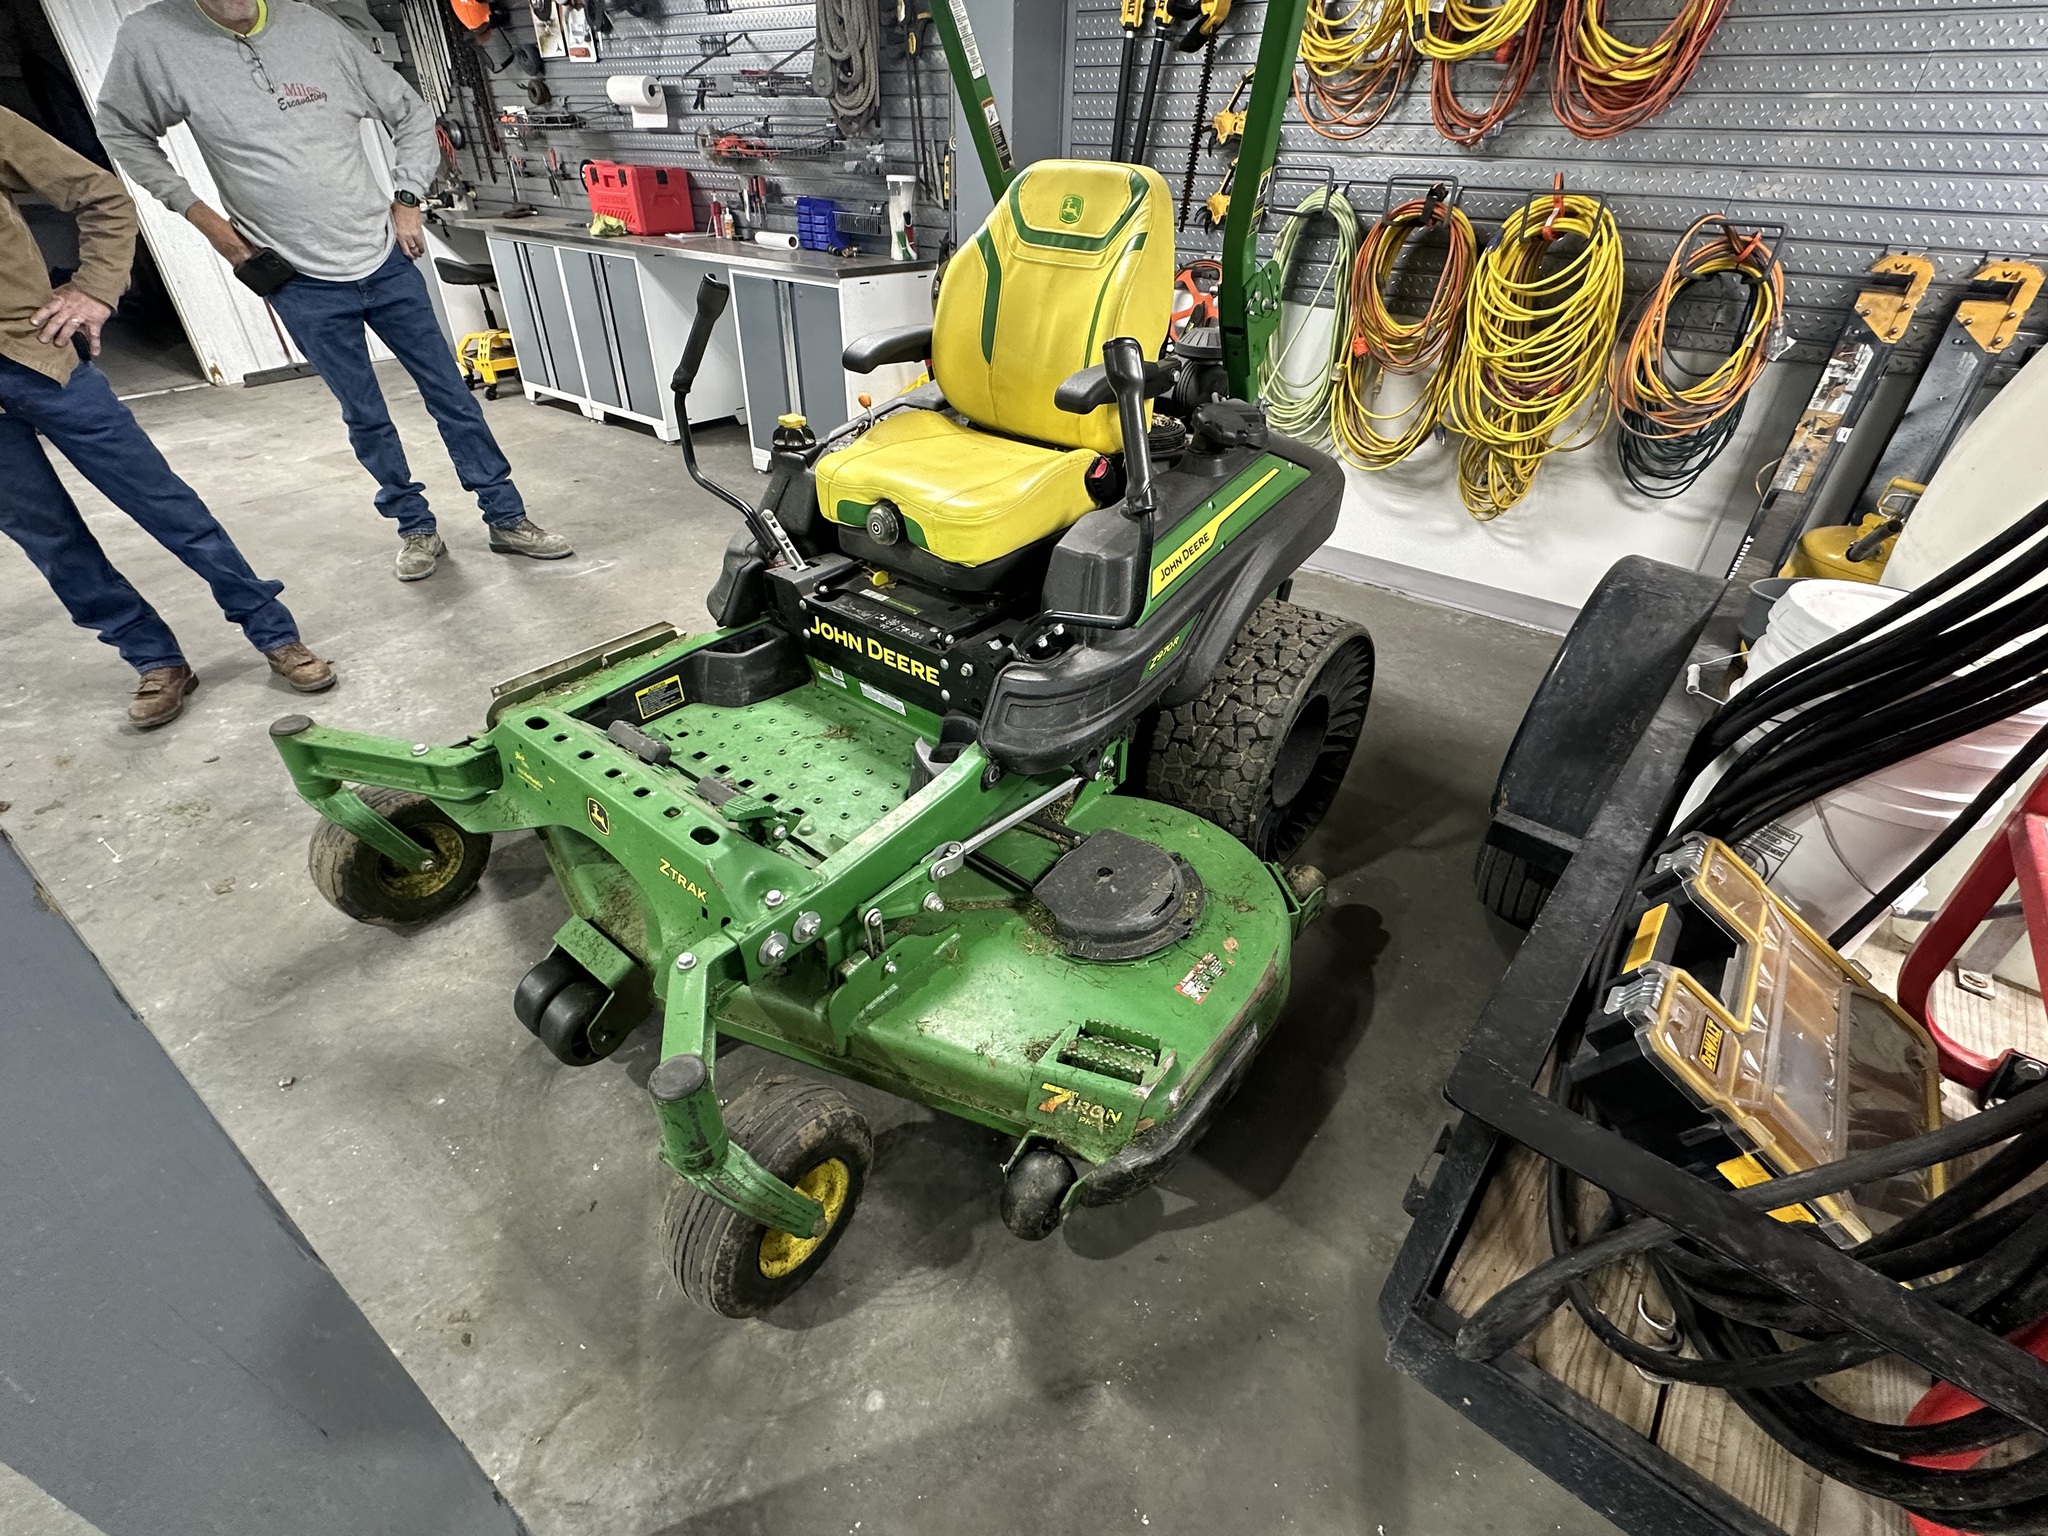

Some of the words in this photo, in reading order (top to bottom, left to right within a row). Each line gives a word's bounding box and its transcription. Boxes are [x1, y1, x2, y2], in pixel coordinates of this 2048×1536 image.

[277, 91, 328, 111] Excavating
[282, 82, 320, 97] Miles
[1160, 555, 1183, 582] JOHN
[1181, 532, 1210, 561] DEERE
[810, 615, 863, 654] JOHN
[866, 636, 940, 687] DEERE
[1148, 635, 1180, 671] Z970R
[659, 857, 708, 904] ZTRAK
[1700, 1018, 1722, 1071] DEWALT
